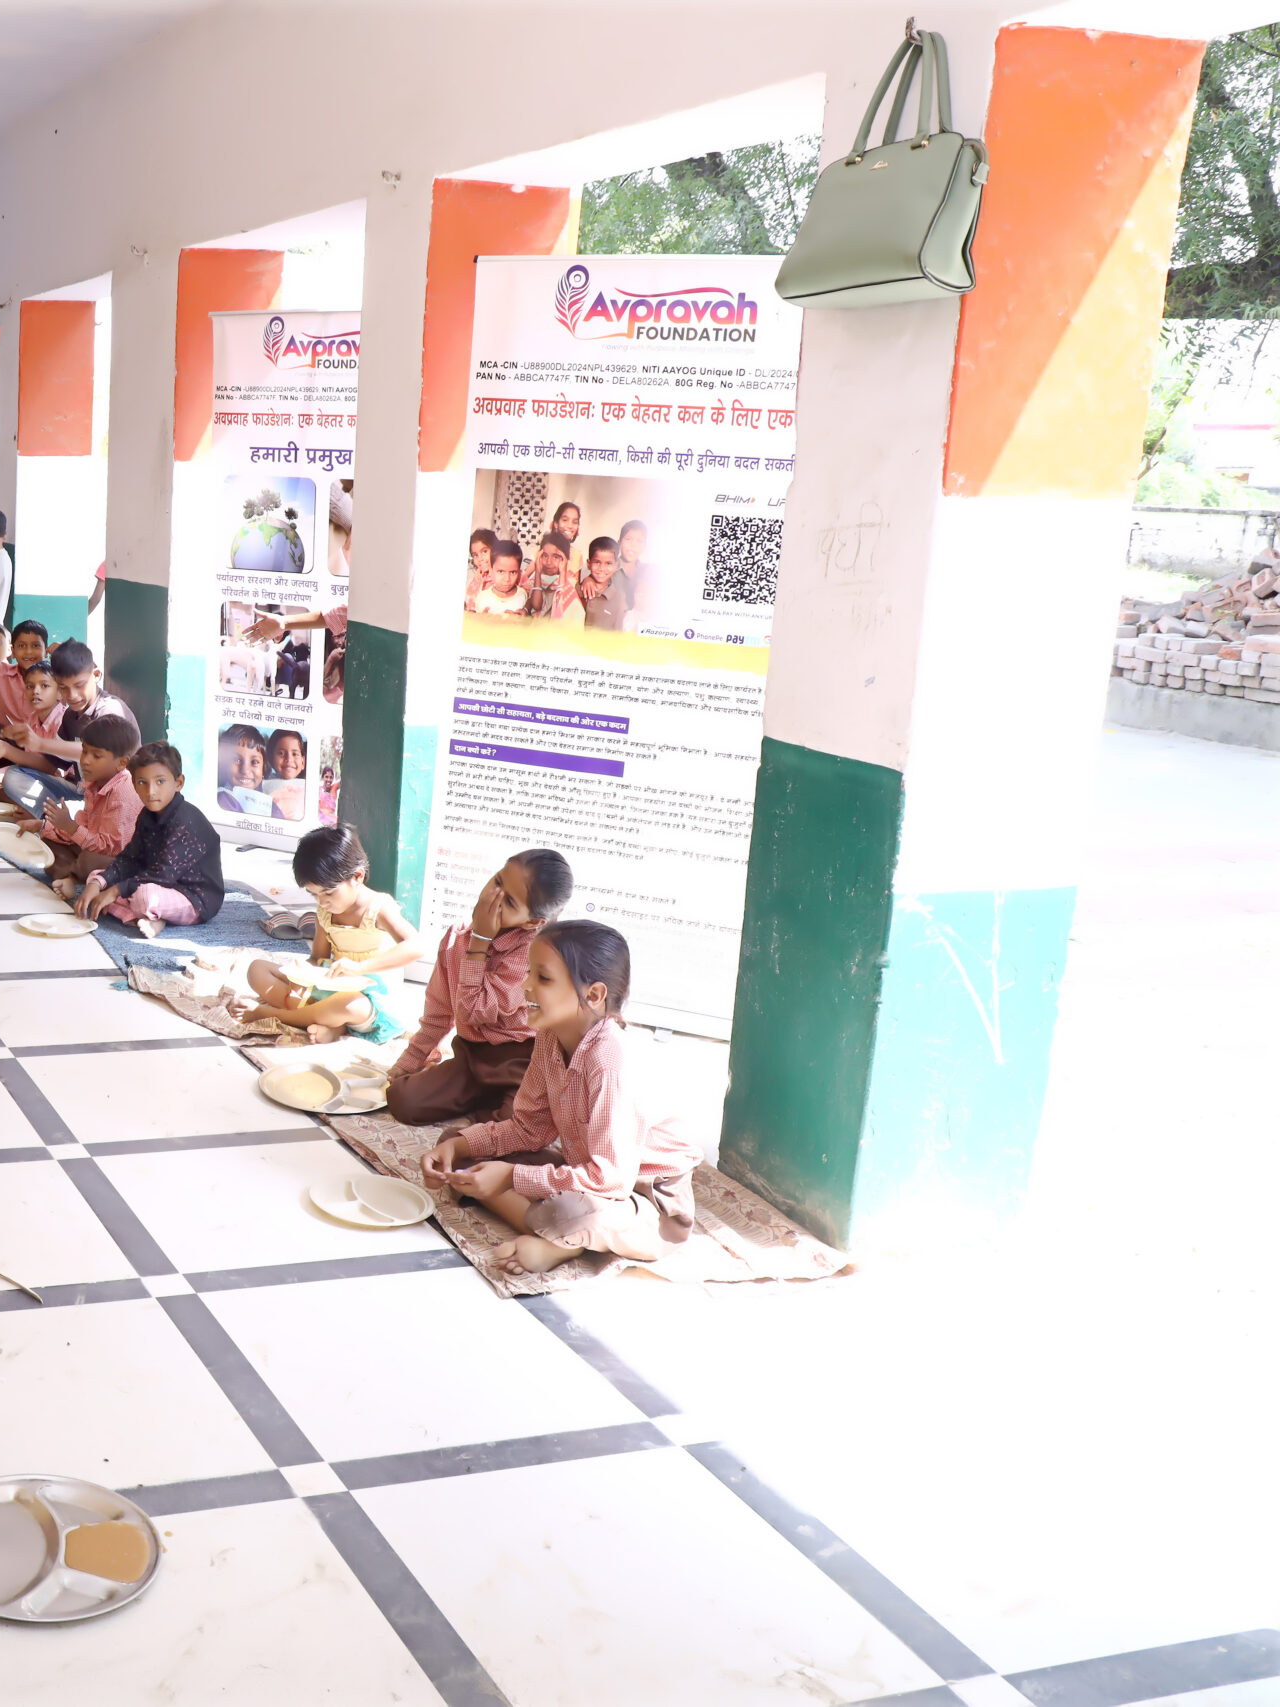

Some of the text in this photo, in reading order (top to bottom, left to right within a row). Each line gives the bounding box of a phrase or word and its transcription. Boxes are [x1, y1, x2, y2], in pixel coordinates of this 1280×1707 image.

[583, 290, 758, 338] Avpravah
[636, 325, 756, 343] FOUNDATION
[282, 334, 360, 368] Avprav
[317, 359, 359, 369] FOUND
[642, 366, 660, 374] NITI
[662, 366, 696, 375] AAYOG
[700, 368, 732, 377] Unique
[736, 368, 745, 376] ID
[476, 372, 492, 380] PAN
[575, 376, 588, 384] TIN
[592, 376, 603, 384] No
[675, 379, 693, 387] 80G
[696, 380, 716, 389] Reg.
[298, 414, 314, 428] एक
[317, 408, 344, 428] बेहतर
[473, 397, 527, 418] अवप्रवाह
[601, 402, 626, 422] एक
[631, 395, 672, 423] बेहतर
[677, 405, 705, 424] कल
[711, 399, 726, 425] के
[731, 399, 762, 429] लिए
[767, 409, 795, 430] एक
[250, 441, 354, 471] हमारी प्रमुख
[478, 439, 509, 456] आपकी
[513, 444, 530, 457] एक
[627, 445, 653, 464] किसी
[657, 447, 671, 465] की
[676, 448, 694, 471] पूरी
[697, 449, 730, 473] दुनिया
[734, 456, 760, 470] बदल
[715, 494, 751, 504] BHIM
[274, 576, 288, 586] और
[252, 588, 259, 598] के
[262, 589, 276, 600] लिए
[236, 697, 245, 705] पर
[248, 698, 264, 708] रहने
[222, 706, 236, 717] और
[265, 714, 274, 722] का
